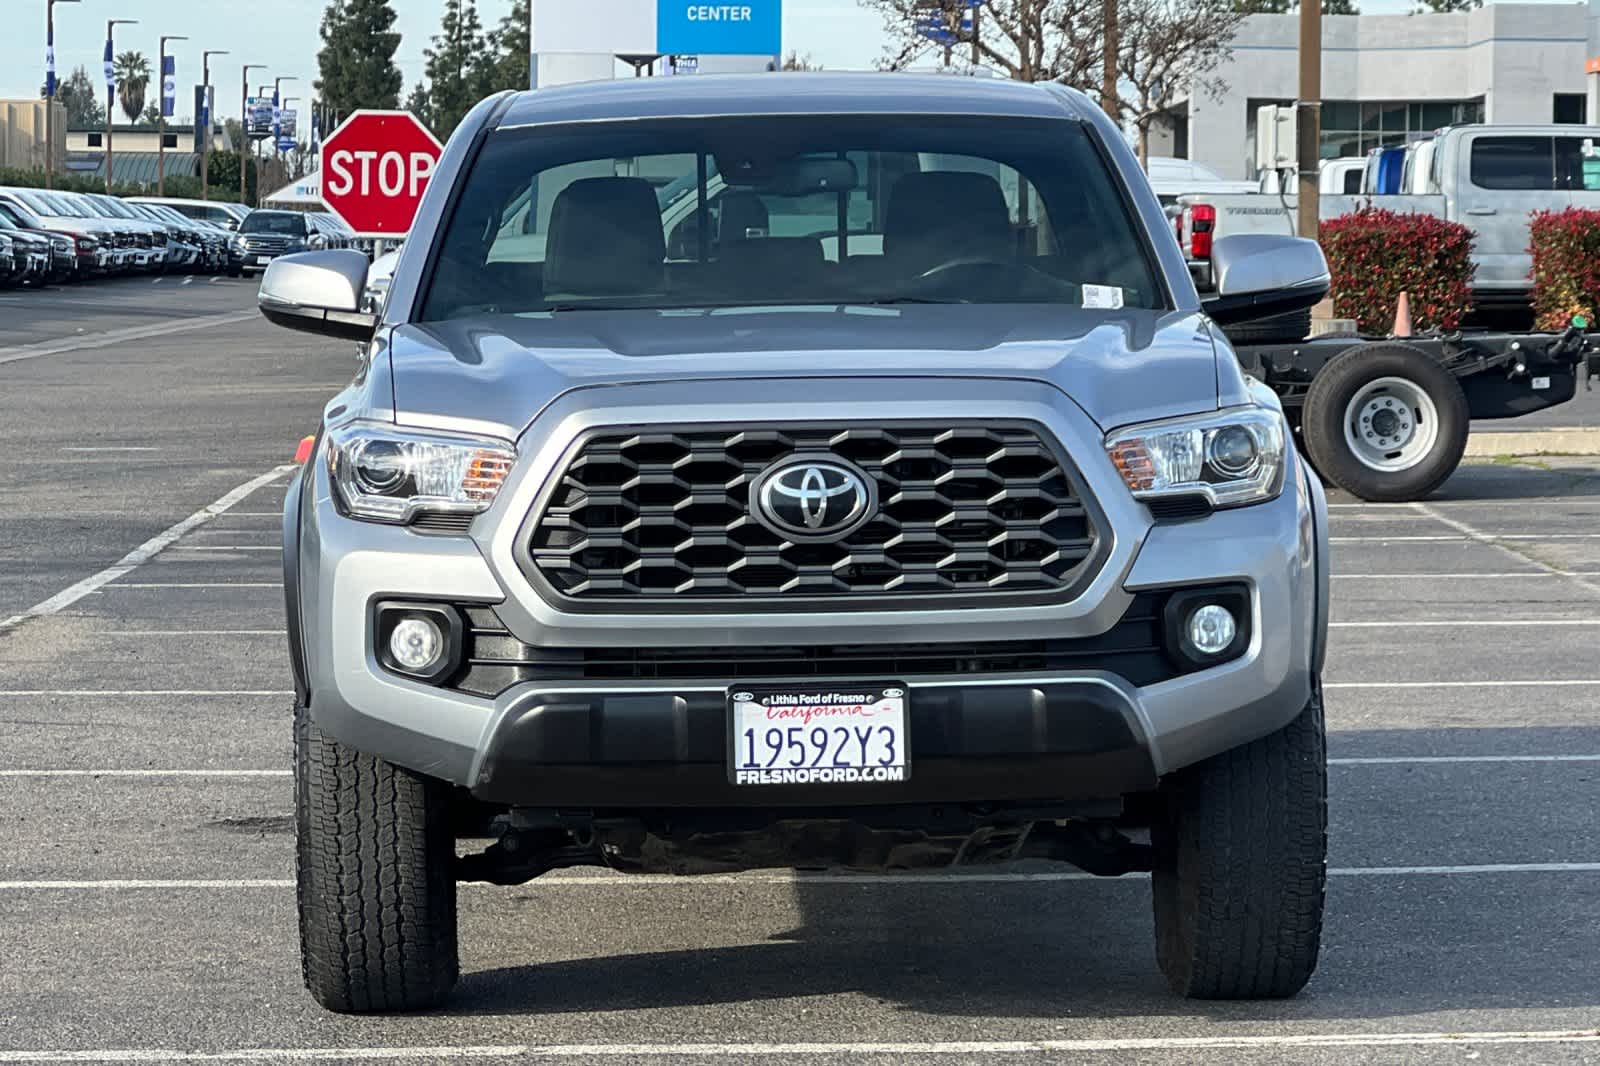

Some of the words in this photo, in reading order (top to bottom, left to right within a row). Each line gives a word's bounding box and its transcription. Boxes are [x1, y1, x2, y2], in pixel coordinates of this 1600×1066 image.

[687, 6, 752, 21] CENTER
[328, 150, 436, 197] STOP
[771, 694, 798, 705] Lithia
[799, 693, 820, 704] Ford
[821, 693, 832, 703] of
[833, 693, 865, 704] Fresno
[766, 704, 875, 724] California
[743, 726, 895, 768] 19592Y3
[736, 767, 904, 785] FRESNOFORD.COM
